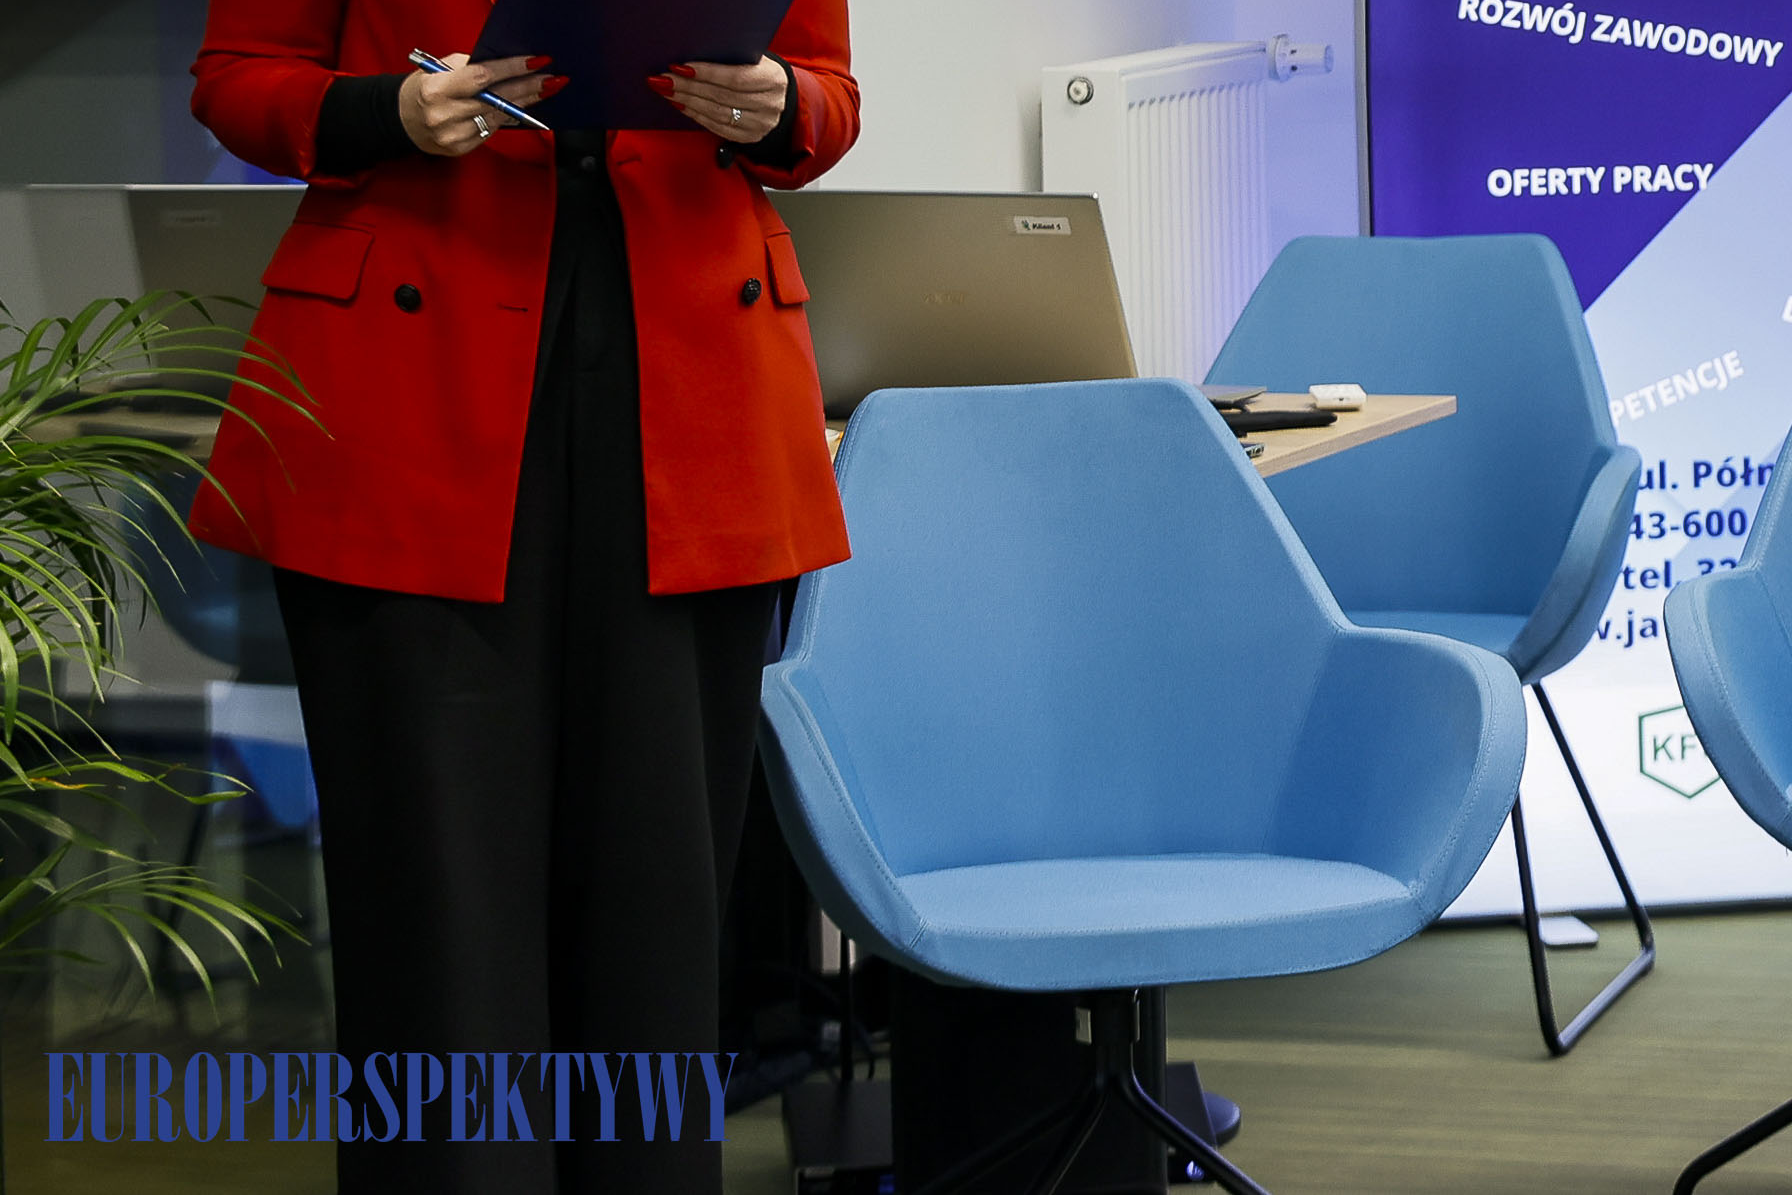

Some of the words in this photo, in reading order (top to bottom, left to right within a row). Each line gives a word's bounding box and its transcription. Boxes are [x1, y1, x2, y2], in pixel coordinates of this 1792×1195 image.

[1591, 14, 1783, 67] ZAWODOWY
[1487, 167, 1605, 197] OFERTY
[1613, 163, 1714, 193] PRACY
